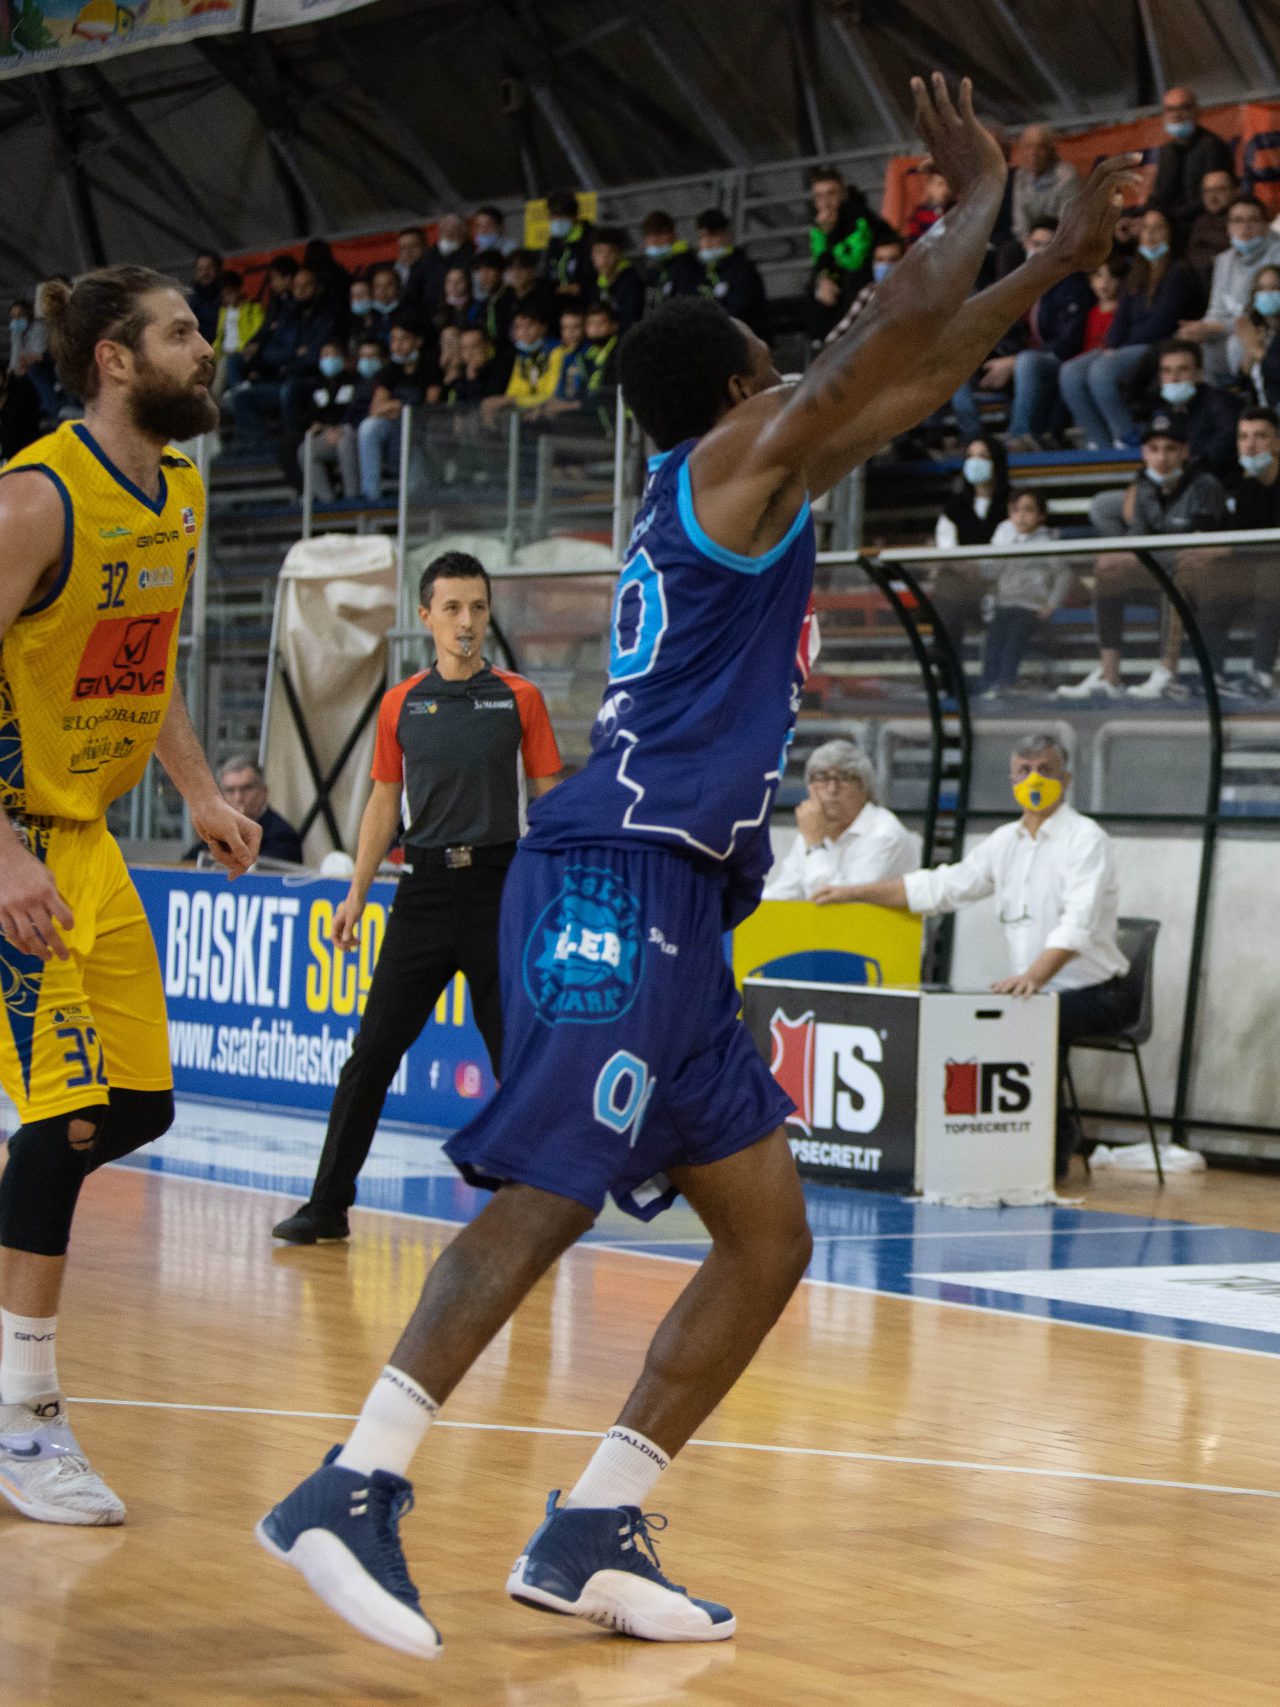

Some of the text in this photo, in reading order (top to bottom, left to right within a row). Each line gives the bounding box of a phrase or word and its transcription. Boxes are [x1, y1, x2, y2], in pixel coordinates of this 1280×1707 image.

[97, 561, 129, 610] 32
[75, 670, 165, 697] GIVOVA
[165, 889, 299, 1009] BASKET
[56, 1027, 109, 1089] 32
[944, 1121, 1032, 1134] TOPSECRET.IT
[789, 1138, 882, 1172] PSECRET.IT
[384, 1370, 438, 1418] PALDING
[606, 1430, 669, 1471] PALDING
